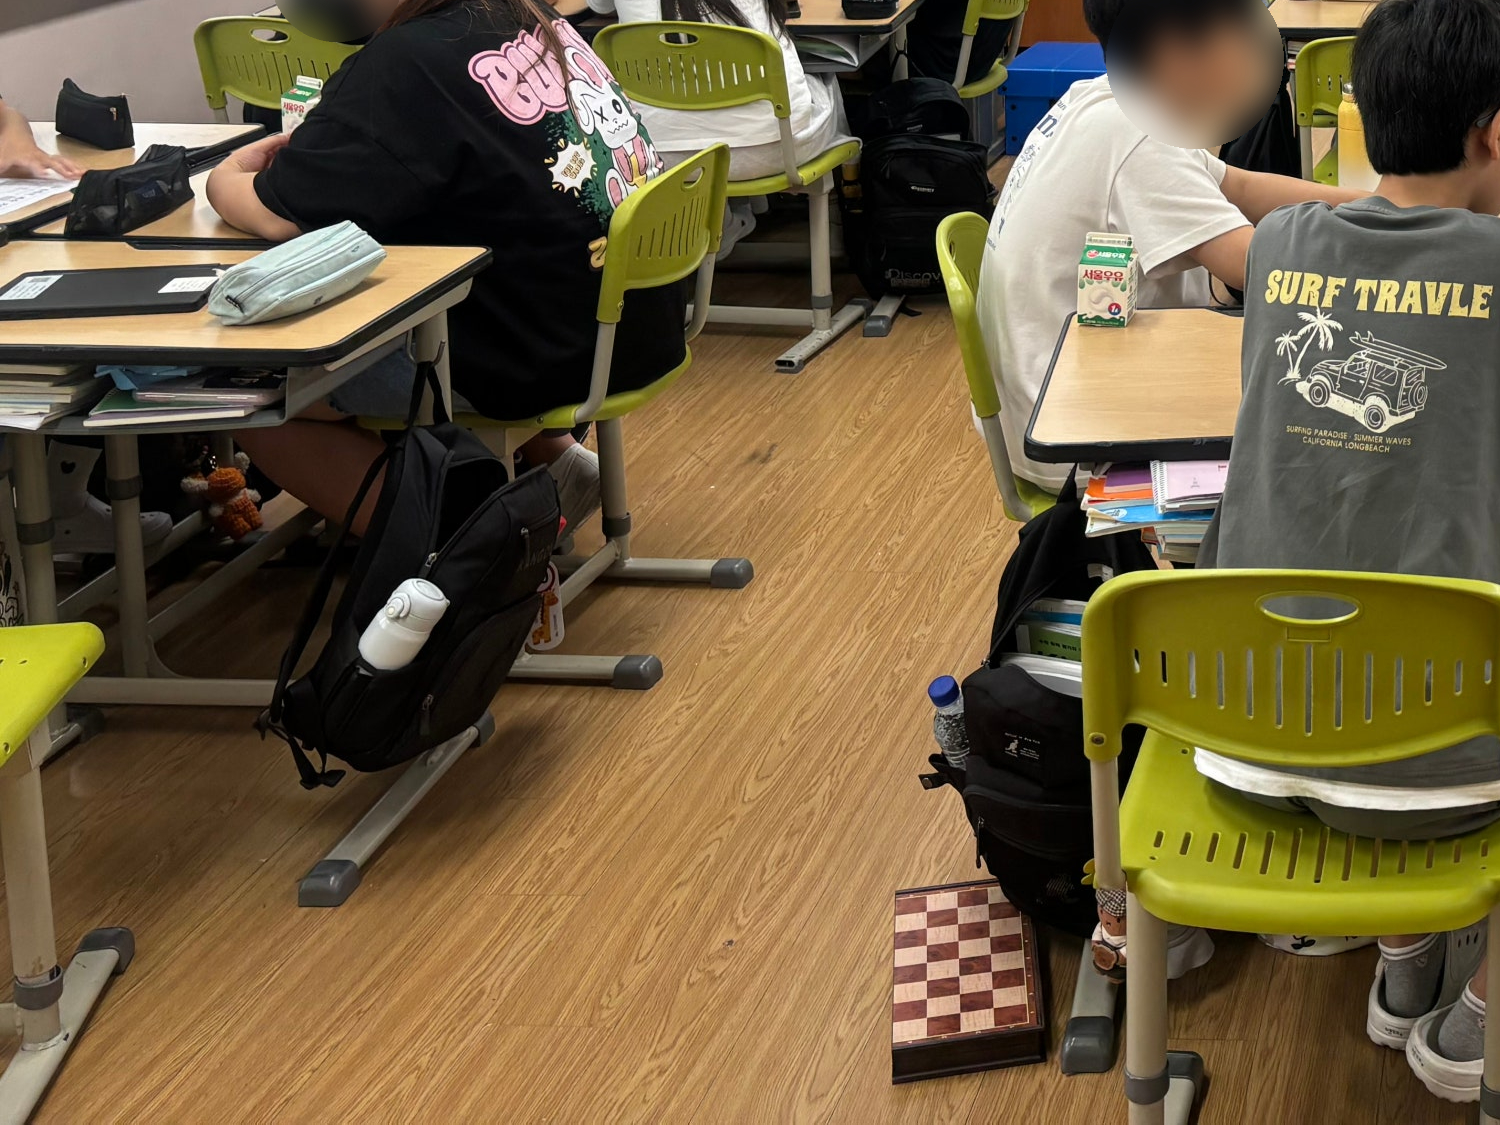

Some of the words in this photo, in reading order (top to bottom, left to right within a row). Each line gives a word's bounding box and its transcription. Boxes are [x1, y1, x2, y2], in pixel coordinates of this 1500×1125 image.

[1098, 251, 1126, 259] 서울우유
[1082, 269, 1124, 282] 서울우유
[1264, 269, 1347, 308] SURF
[1353, 278, 1494, 319] TRAVLE
[1286, 425, 1312, 435] SURFING
[1313, 428, 1348, 440] PARADISE
[1353, 433, 1383, 443] SUMMER
[1385, 437, 1412, 446] WAVES
[1302, 436, 1343, 448] CALIFORNIA
[1345, 442, 1391, 453] LONGBEACH
